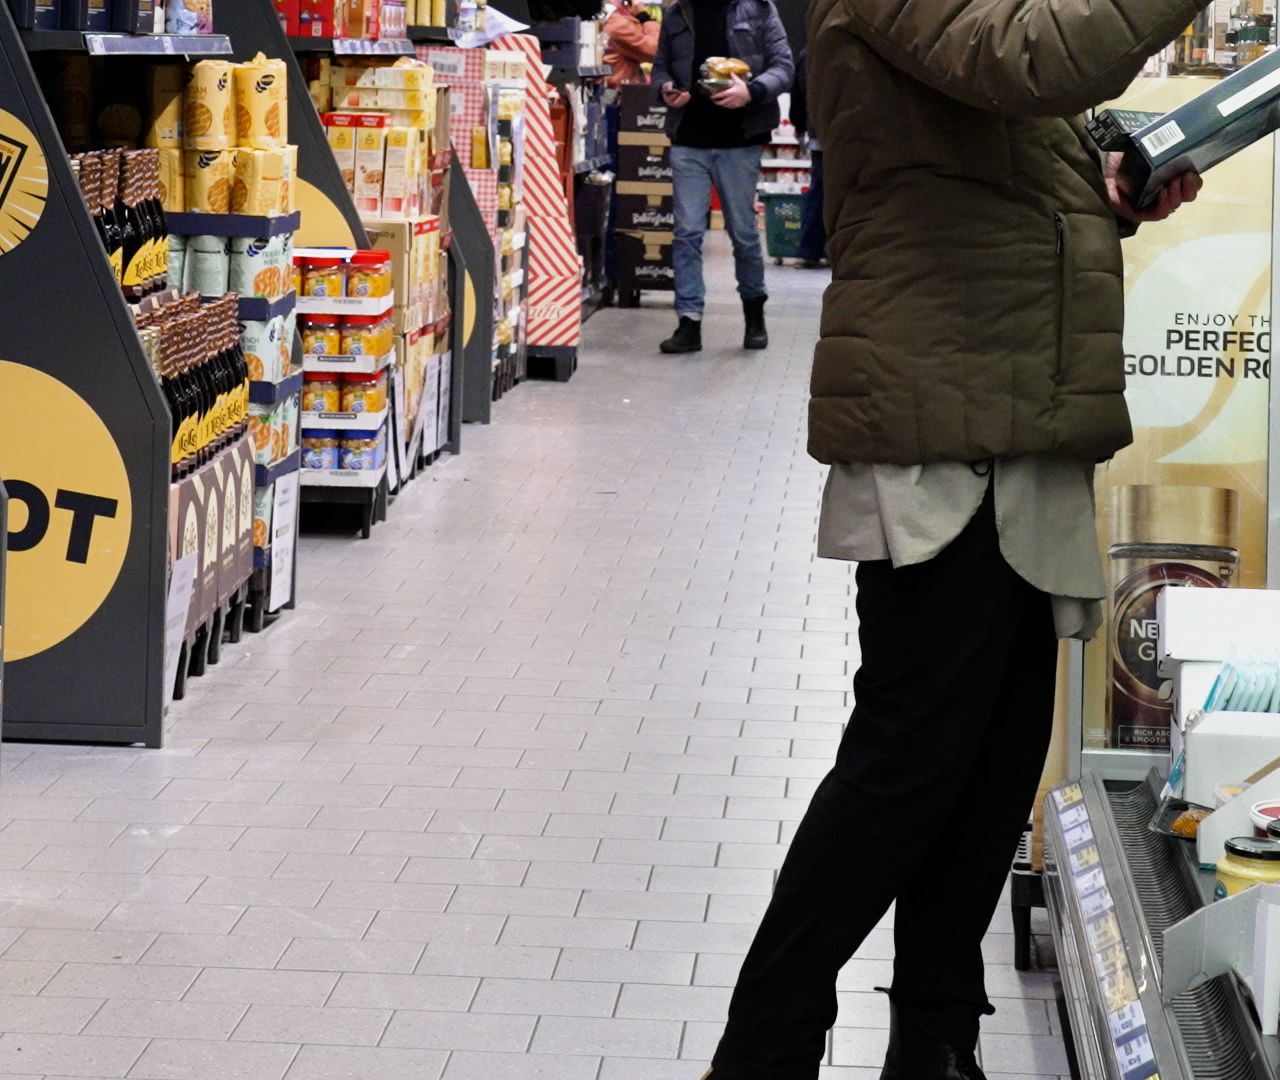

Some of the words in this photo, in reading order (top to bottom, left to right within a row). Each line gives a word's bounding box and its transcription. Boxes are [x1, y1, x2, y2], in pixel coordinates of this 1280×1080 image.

[1175, 312, 1240, 327] ENJOY
[1166, 328, 1271, 353] PERFEC
[1124, 353, 1235, 379] GOLDEN
[1133, 728, 1153, 736] RICH
[1132, 736, 1167, 744] SMOOTH
